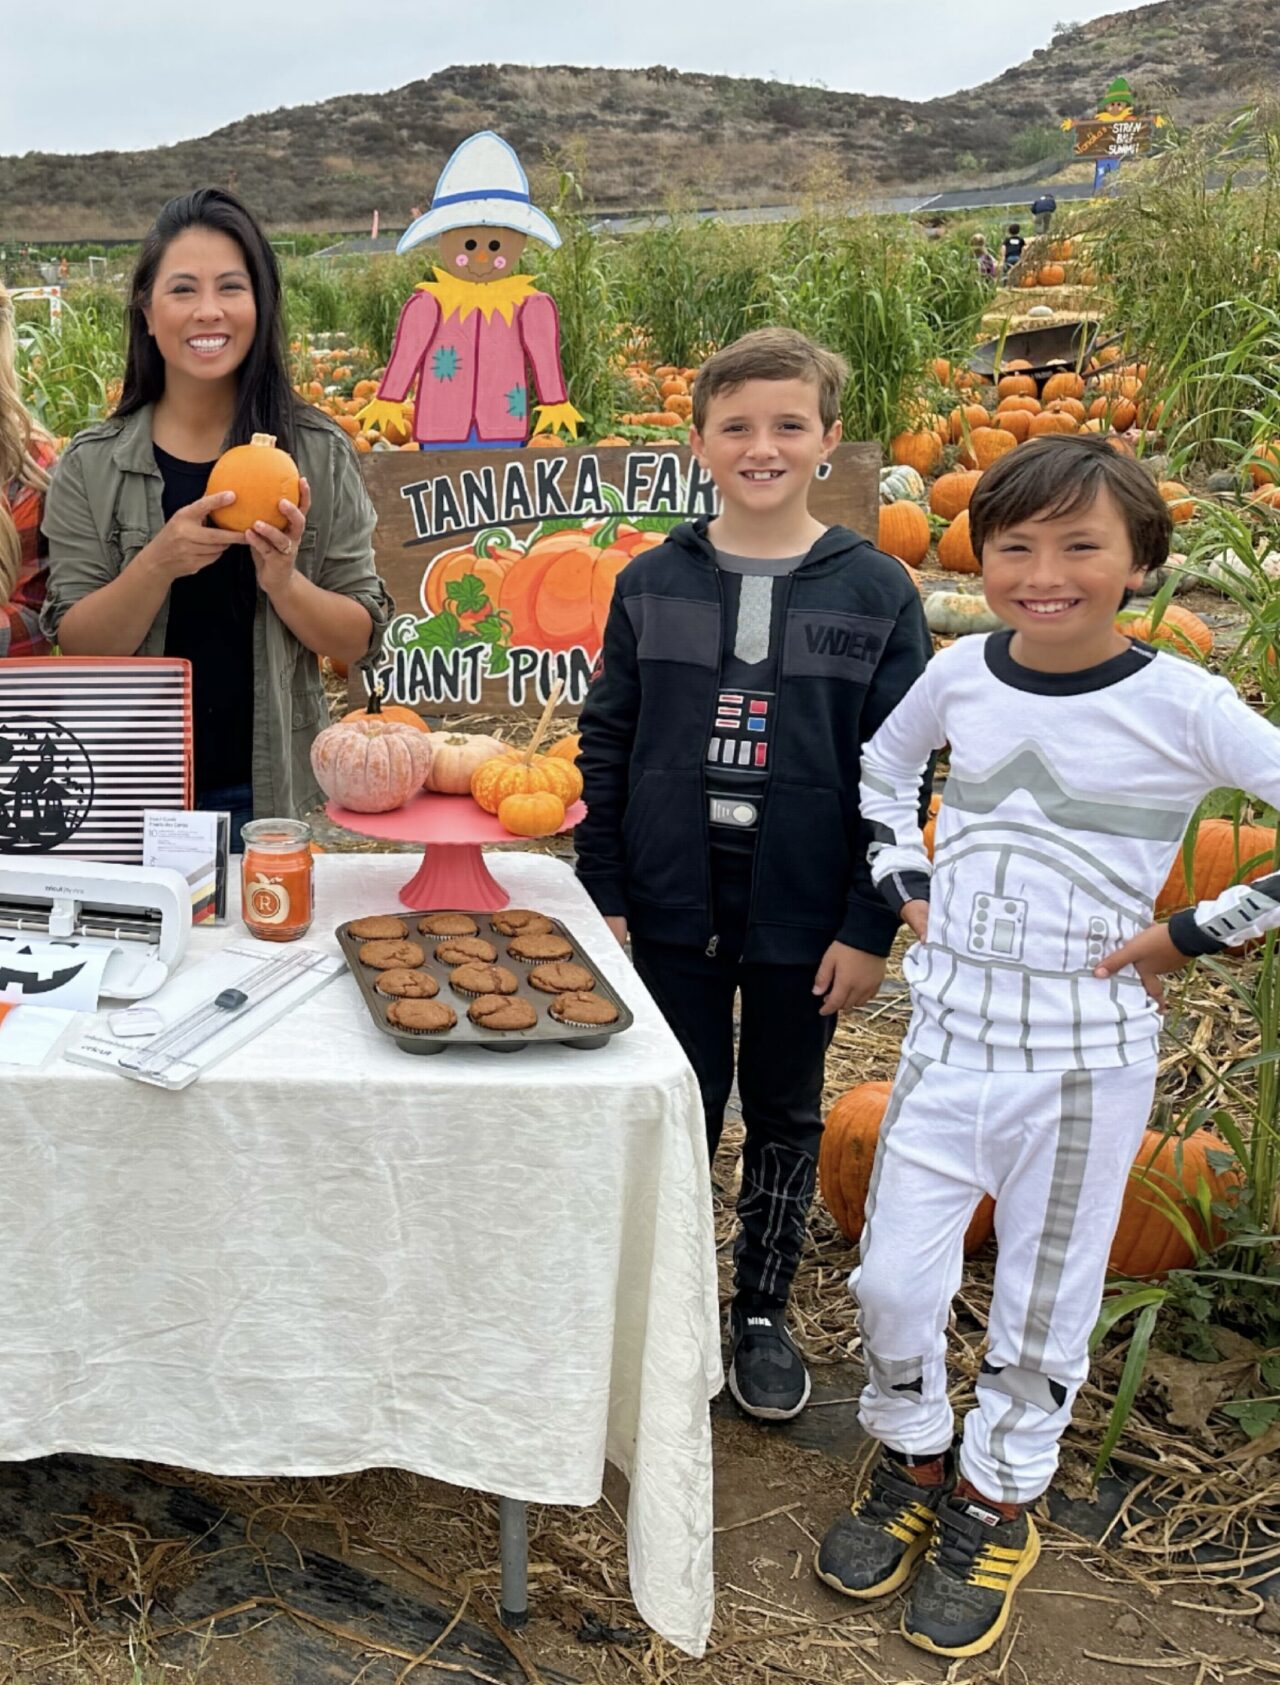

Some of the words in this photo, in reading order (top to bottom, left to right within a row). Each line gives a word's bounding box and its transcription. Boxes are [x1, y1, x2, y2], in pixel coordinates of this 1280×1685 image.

[401, 453, 605, 538] TANAKA
[625, 453, 721, 518] FAR
[804, 623, 882, 666] VADER
[508, 645, 596, 705] PUM
[258, 895, 273, 912] R
